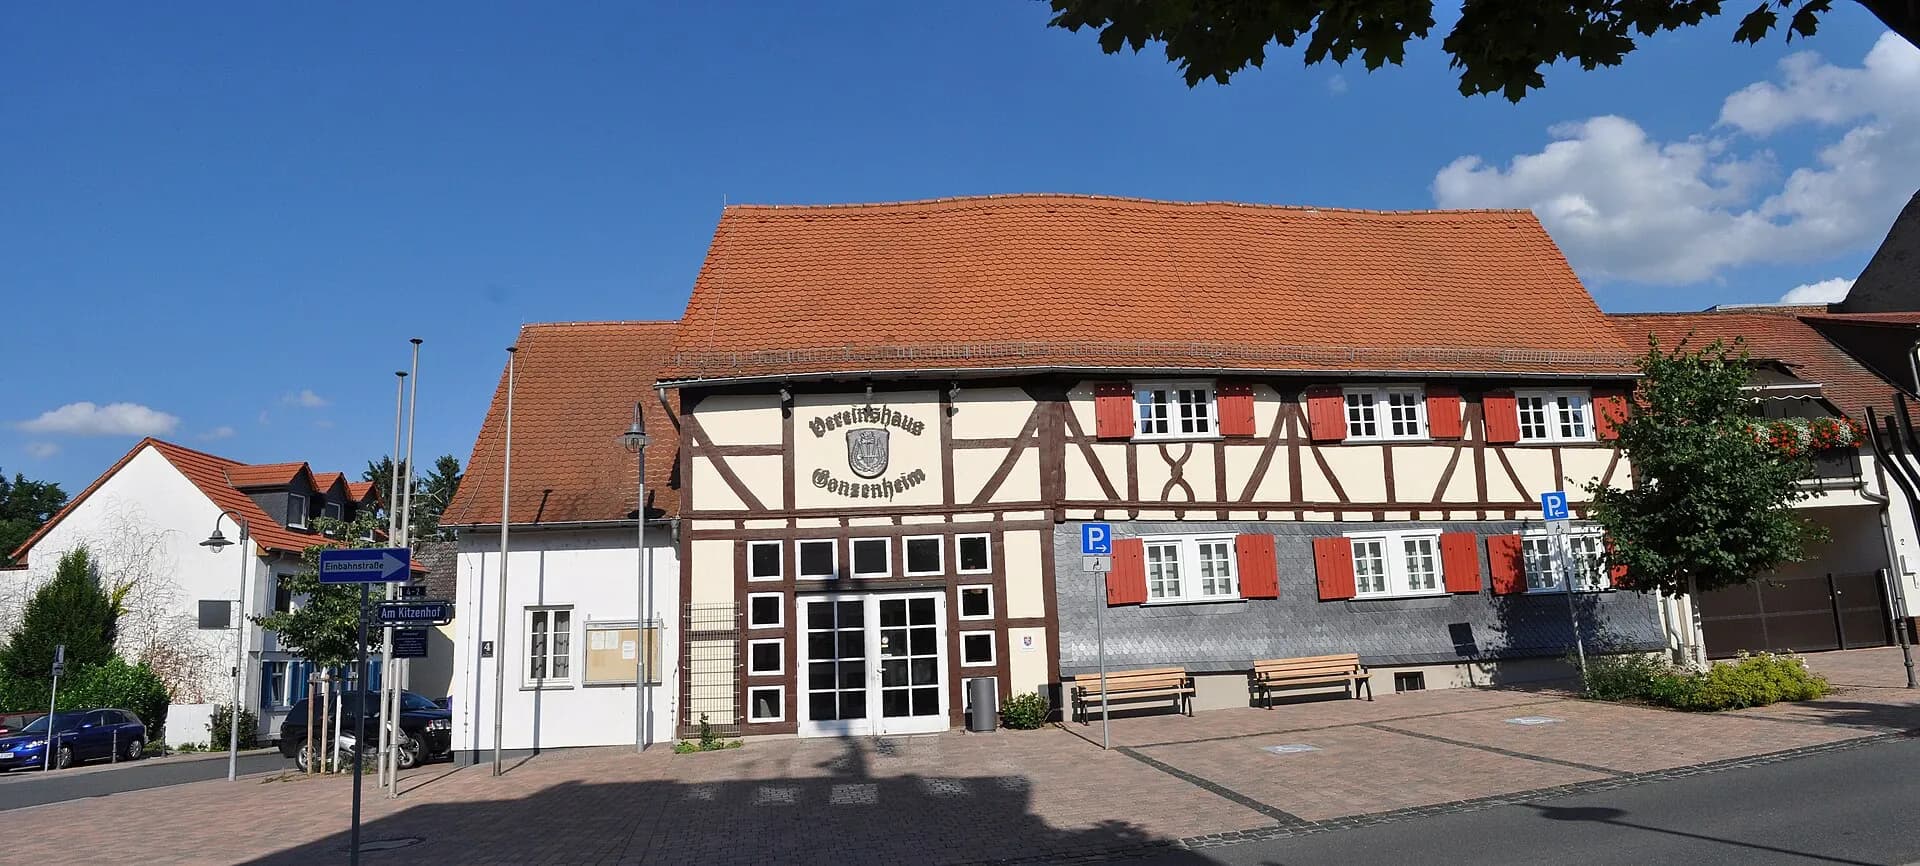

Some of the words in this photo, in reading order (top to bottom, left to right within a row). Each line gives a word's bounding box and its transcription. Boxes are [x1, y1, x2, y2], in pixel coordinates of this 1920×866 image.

[809, 404, 925, 438] Vereinshaus
[812, 468, 926, 502] Gonzenheim
[1547, 495, 1561, 516] P
[1088, 527, 1104, 550] P
[1900, 538, 1905, 546] 2
[325, 561, 384, 571] Einbahnstraße
[381, 607, 395, 618] Am
[398, 606, 441, 618] Kitzenhof
[484, 642, 491, 652] 4
